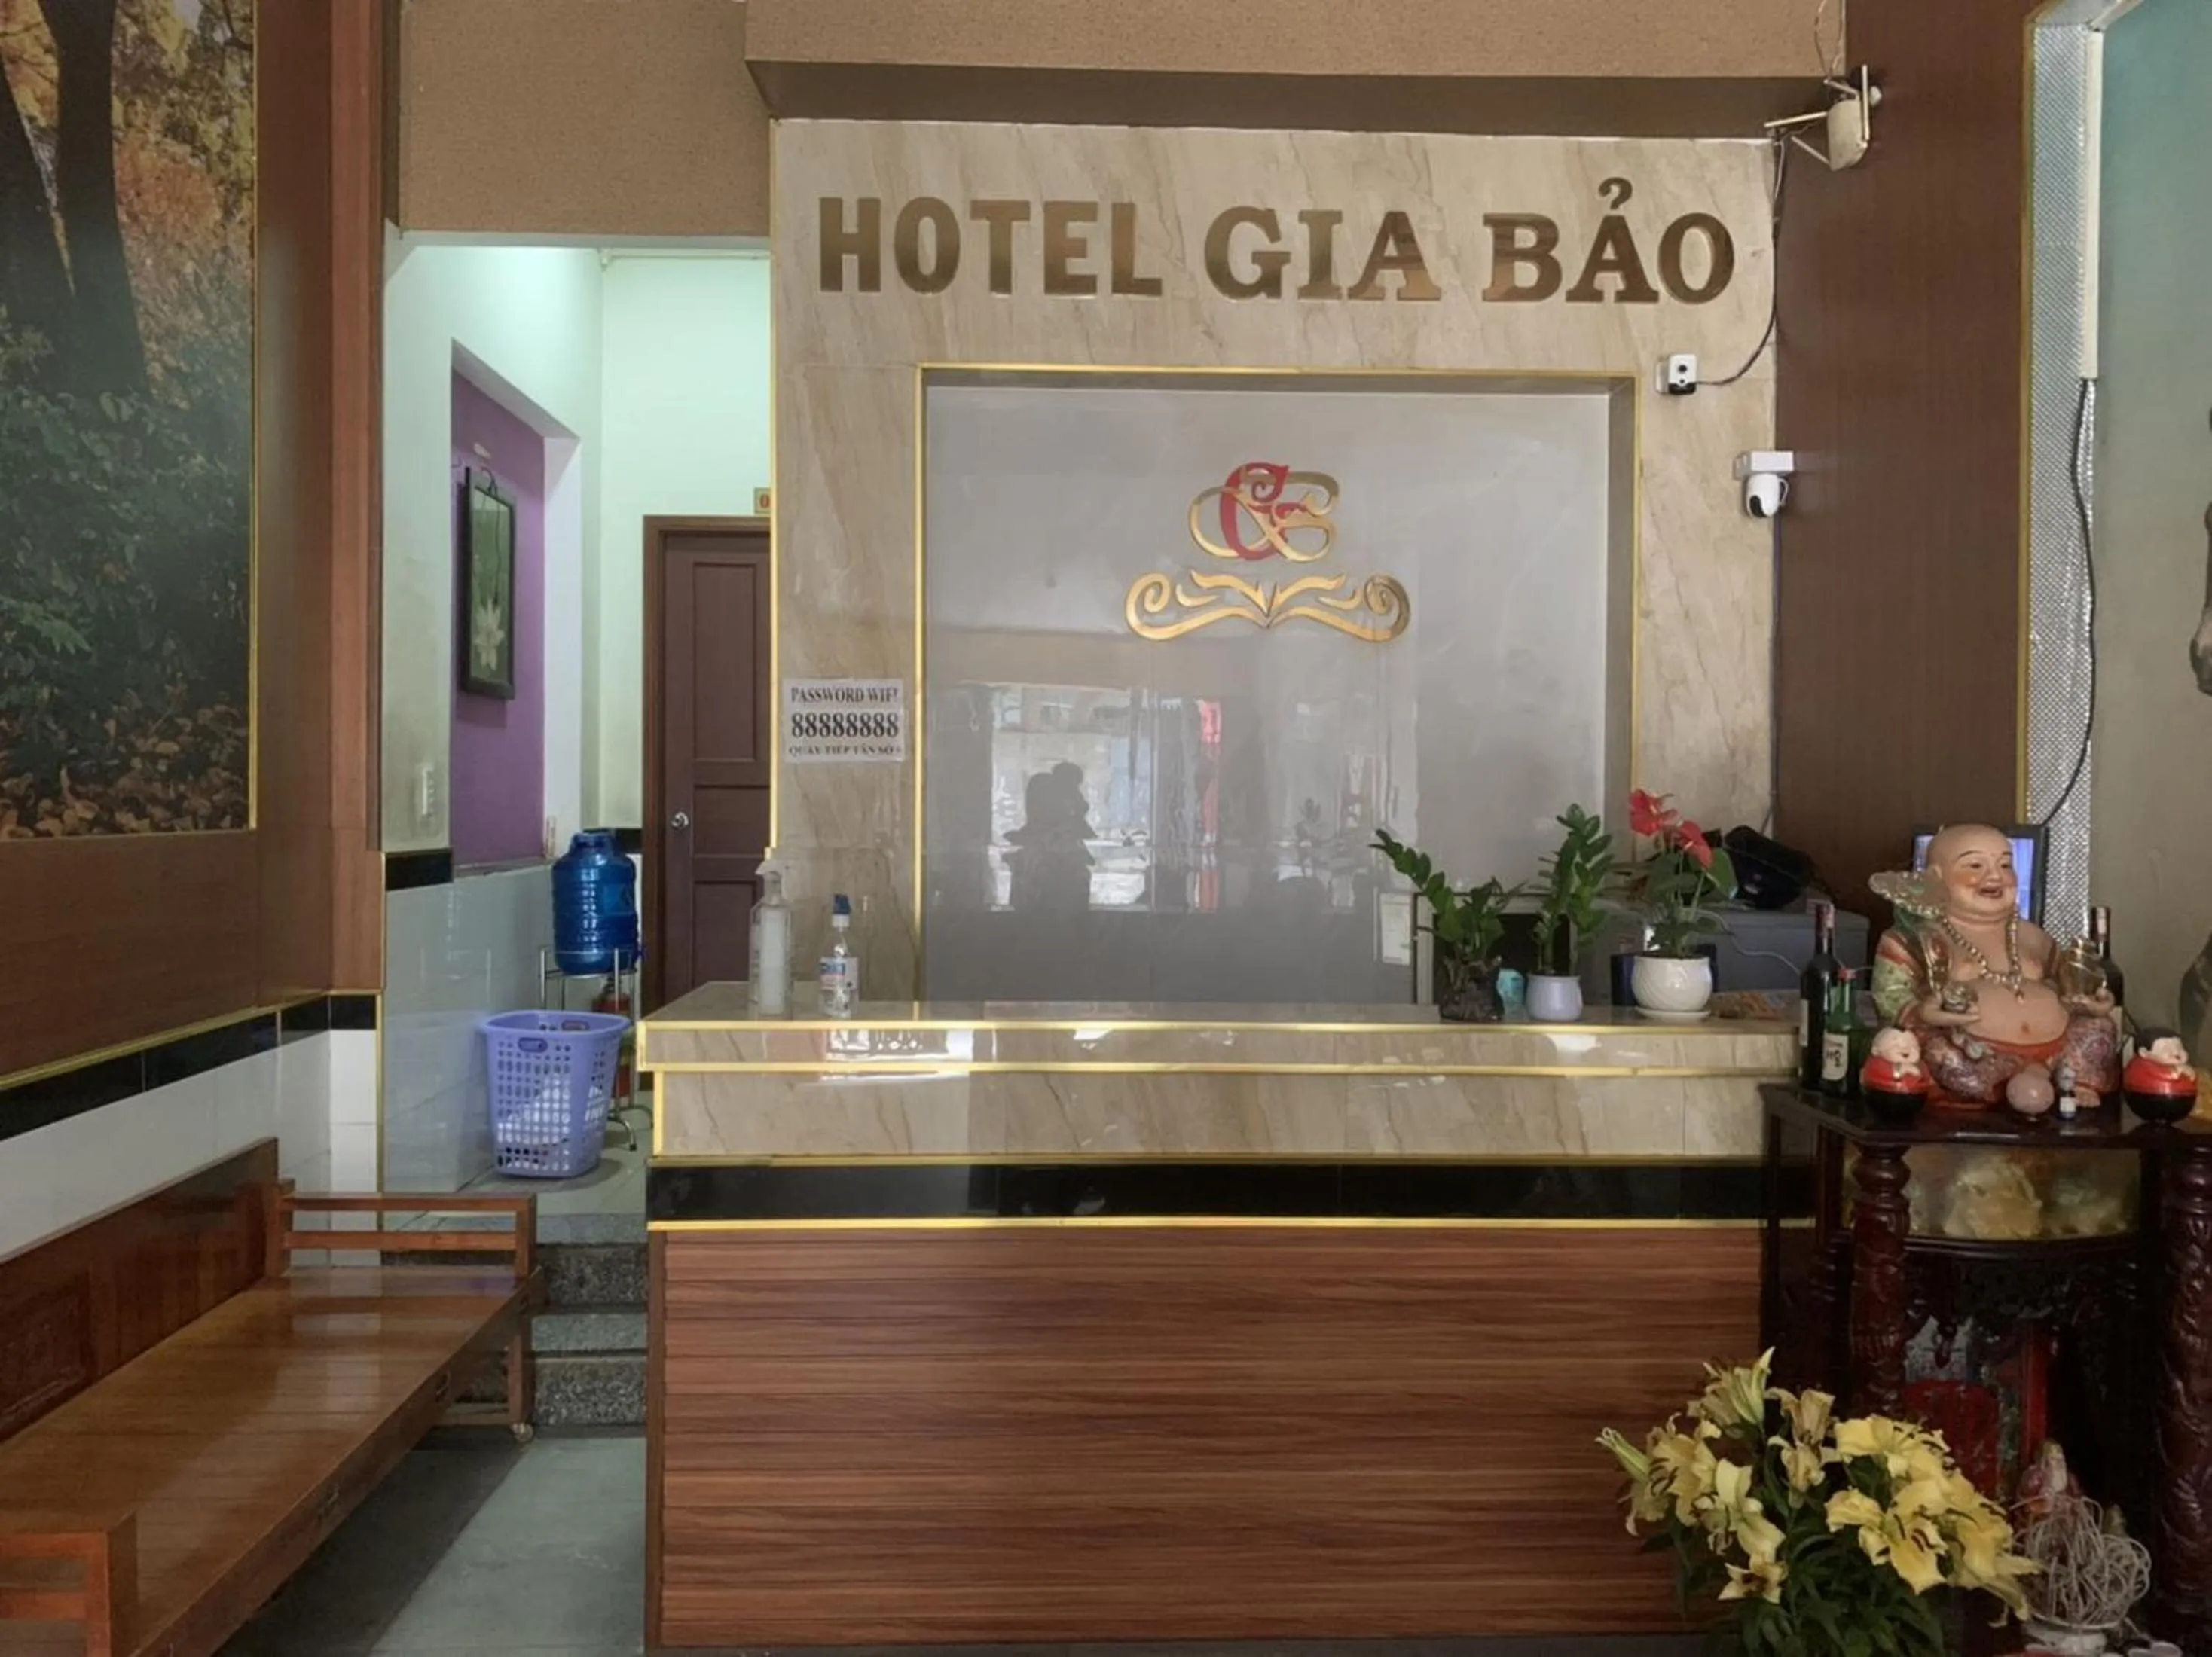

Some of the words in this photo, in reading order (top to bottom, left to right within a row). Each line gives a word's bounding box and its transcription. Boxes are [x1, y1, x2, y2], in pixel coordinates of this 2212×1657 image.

[819, 197, 1163, 297] HOTEL
[1205, 206, 1442, 301] GIA
[1482, 178, 1735, 304] BẢO
[791, 687, 864, 703] PASSWORD
[791, 712, 899, 738] 88888888
